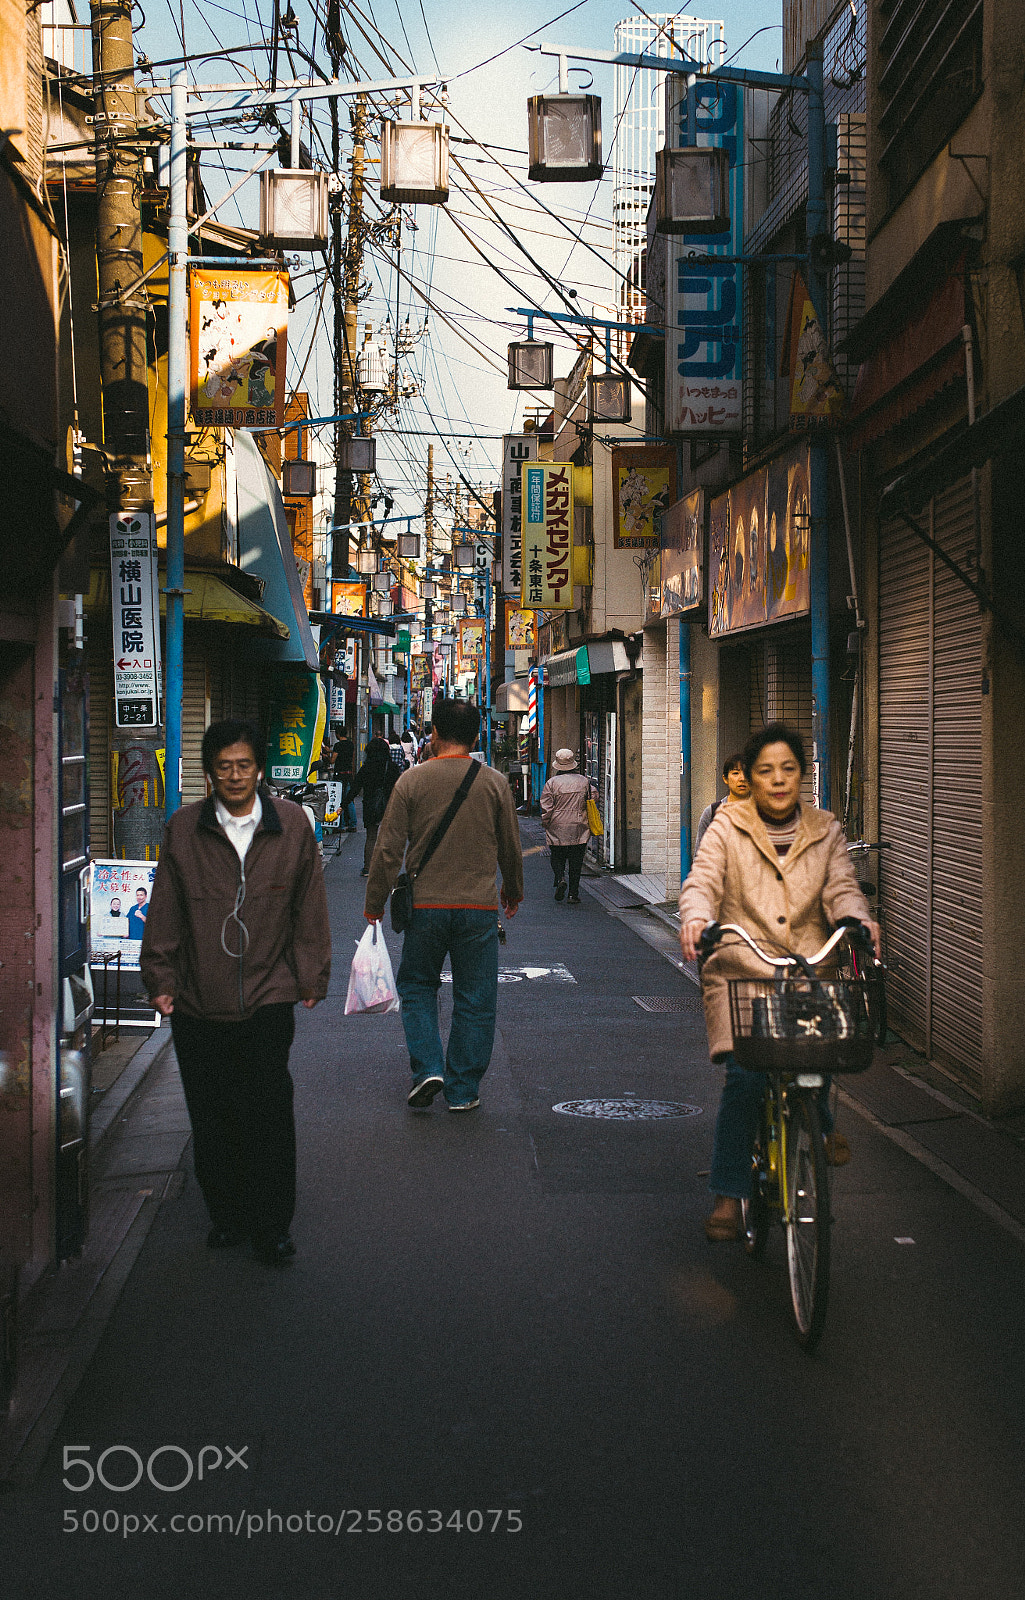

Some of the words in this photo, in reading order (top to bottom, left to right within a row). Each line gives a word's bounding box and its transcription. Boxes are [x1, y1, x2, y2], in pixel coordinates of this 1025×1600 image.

[679, 385, 738, 399] いつもまっ白
[675, 406, 740, 425] ハッピー
[546, 466, 570, 603] メガネセンター
[529, 544, 543, 603] 十条東店
[119, 559, 144, 654] 横山医院
[132, 659, 152, 669] 入口
[122, 704, 148, 713] 中十条
[123, 713, 147, 722] 2-21
[98, 869, 145, 881] 冷え性さん
[98, 882, 131, 893] 大募集
